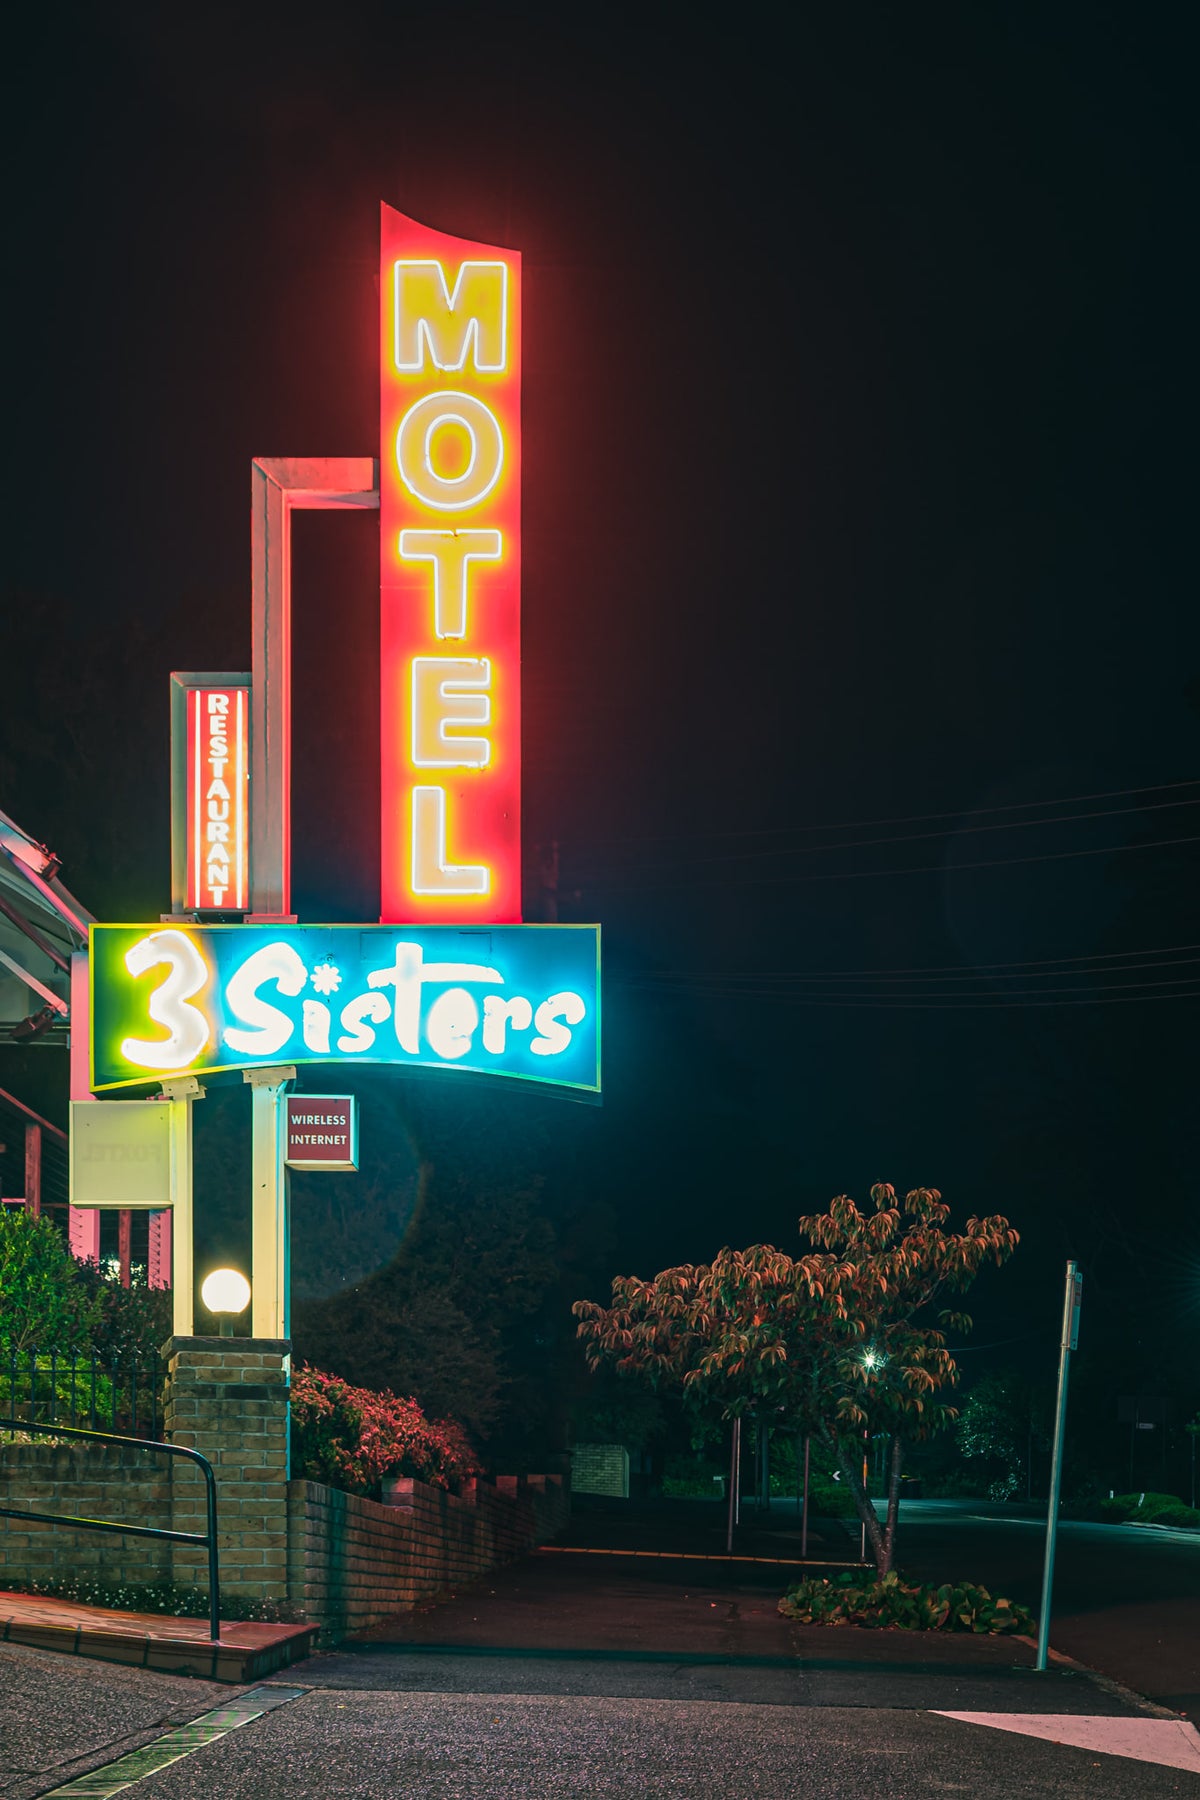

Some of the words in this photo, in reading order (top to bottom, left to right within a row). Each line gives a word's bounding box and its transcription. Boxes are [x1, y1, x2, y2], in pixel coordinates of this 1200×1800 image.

[394, 259, 508, 894] MOTEL
[206, 693, 230, 907] RESTAURANT
[122, 929, 209, 1068] 3
[223, 942, 586, 1059] Sisters
[290, 1134, 347, 1145] INTERNET
[291, 1115, 346, 1126] WIRELESS
